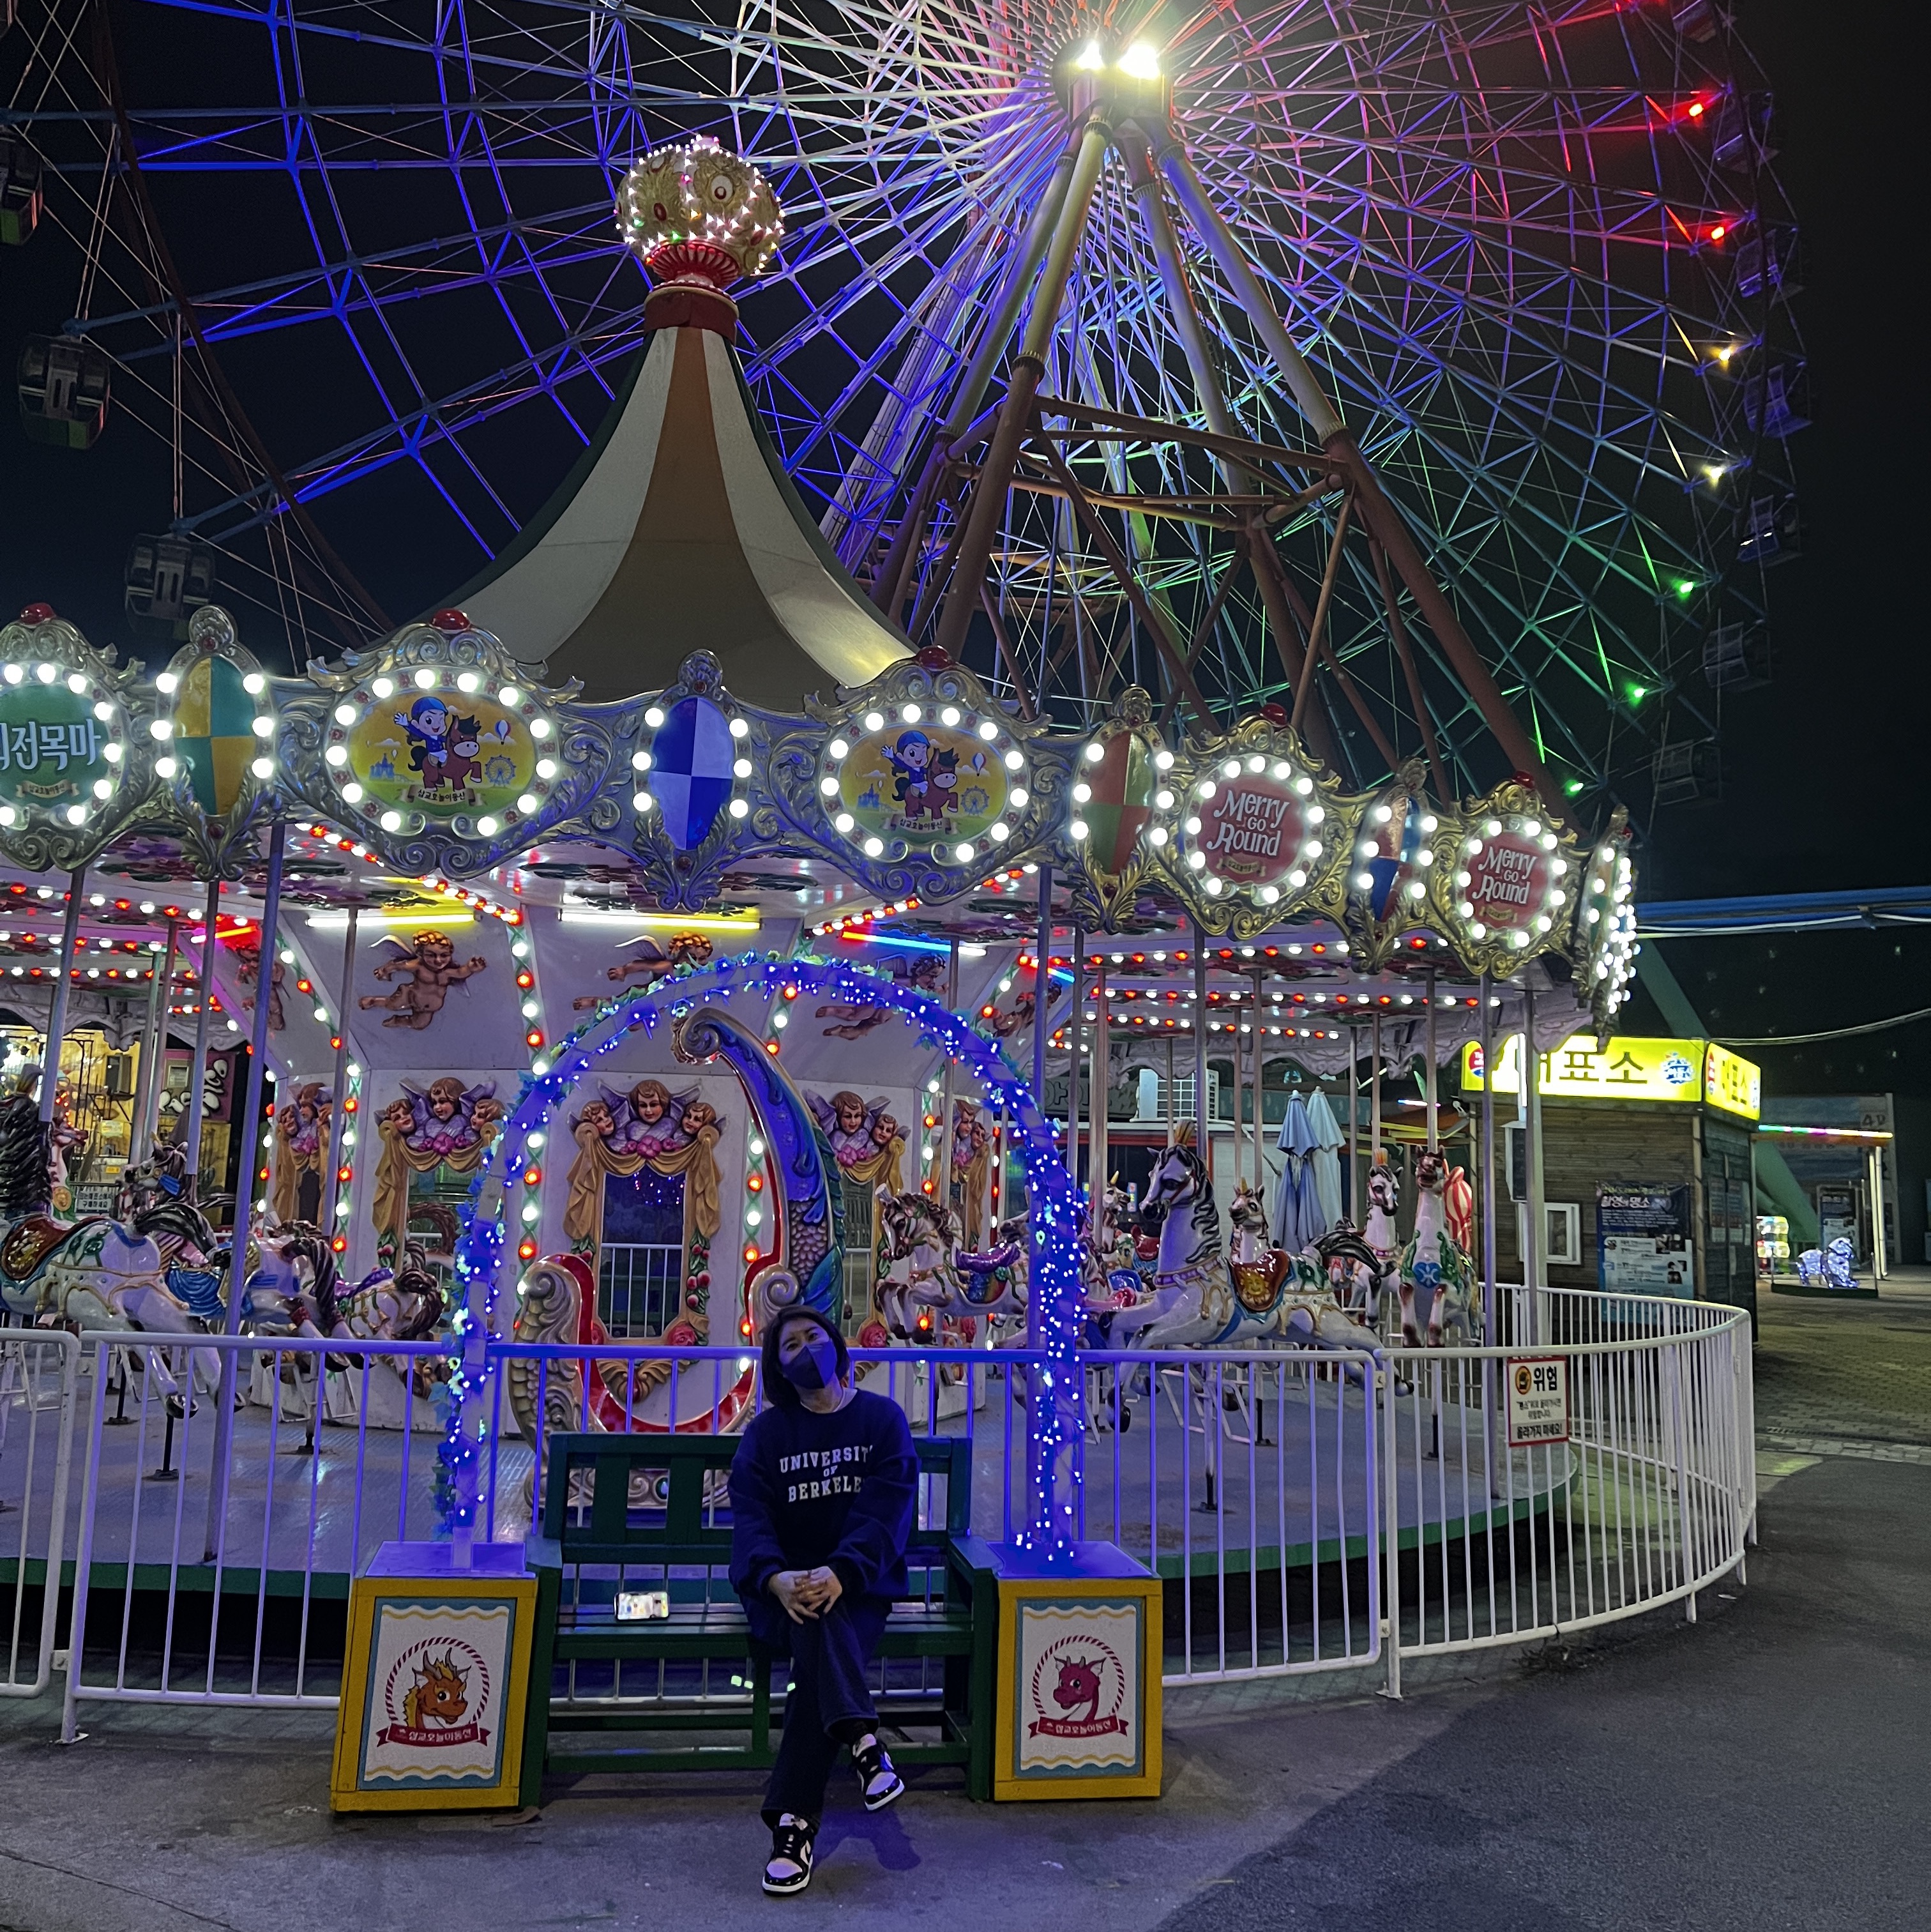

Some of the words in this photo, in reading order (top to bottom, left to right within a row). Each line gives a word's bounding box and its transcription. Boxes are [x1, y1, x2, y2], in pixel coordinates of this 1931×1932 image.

[1213, 789, 1290, 828] Merry
[1247, 816, 1267, 832] GO
[1206, 822, 1282, 856] Round
[1478, 846, 1538, 879] Merry
[1504, 869, 1518, 883] GO
[1472, 875, 1531, 904] Round
[1533, 1365, 1557, 1392] 위험
[823, 1465, 838, 1477] OF
[788, 1475, 865, 1503] BERKELE
